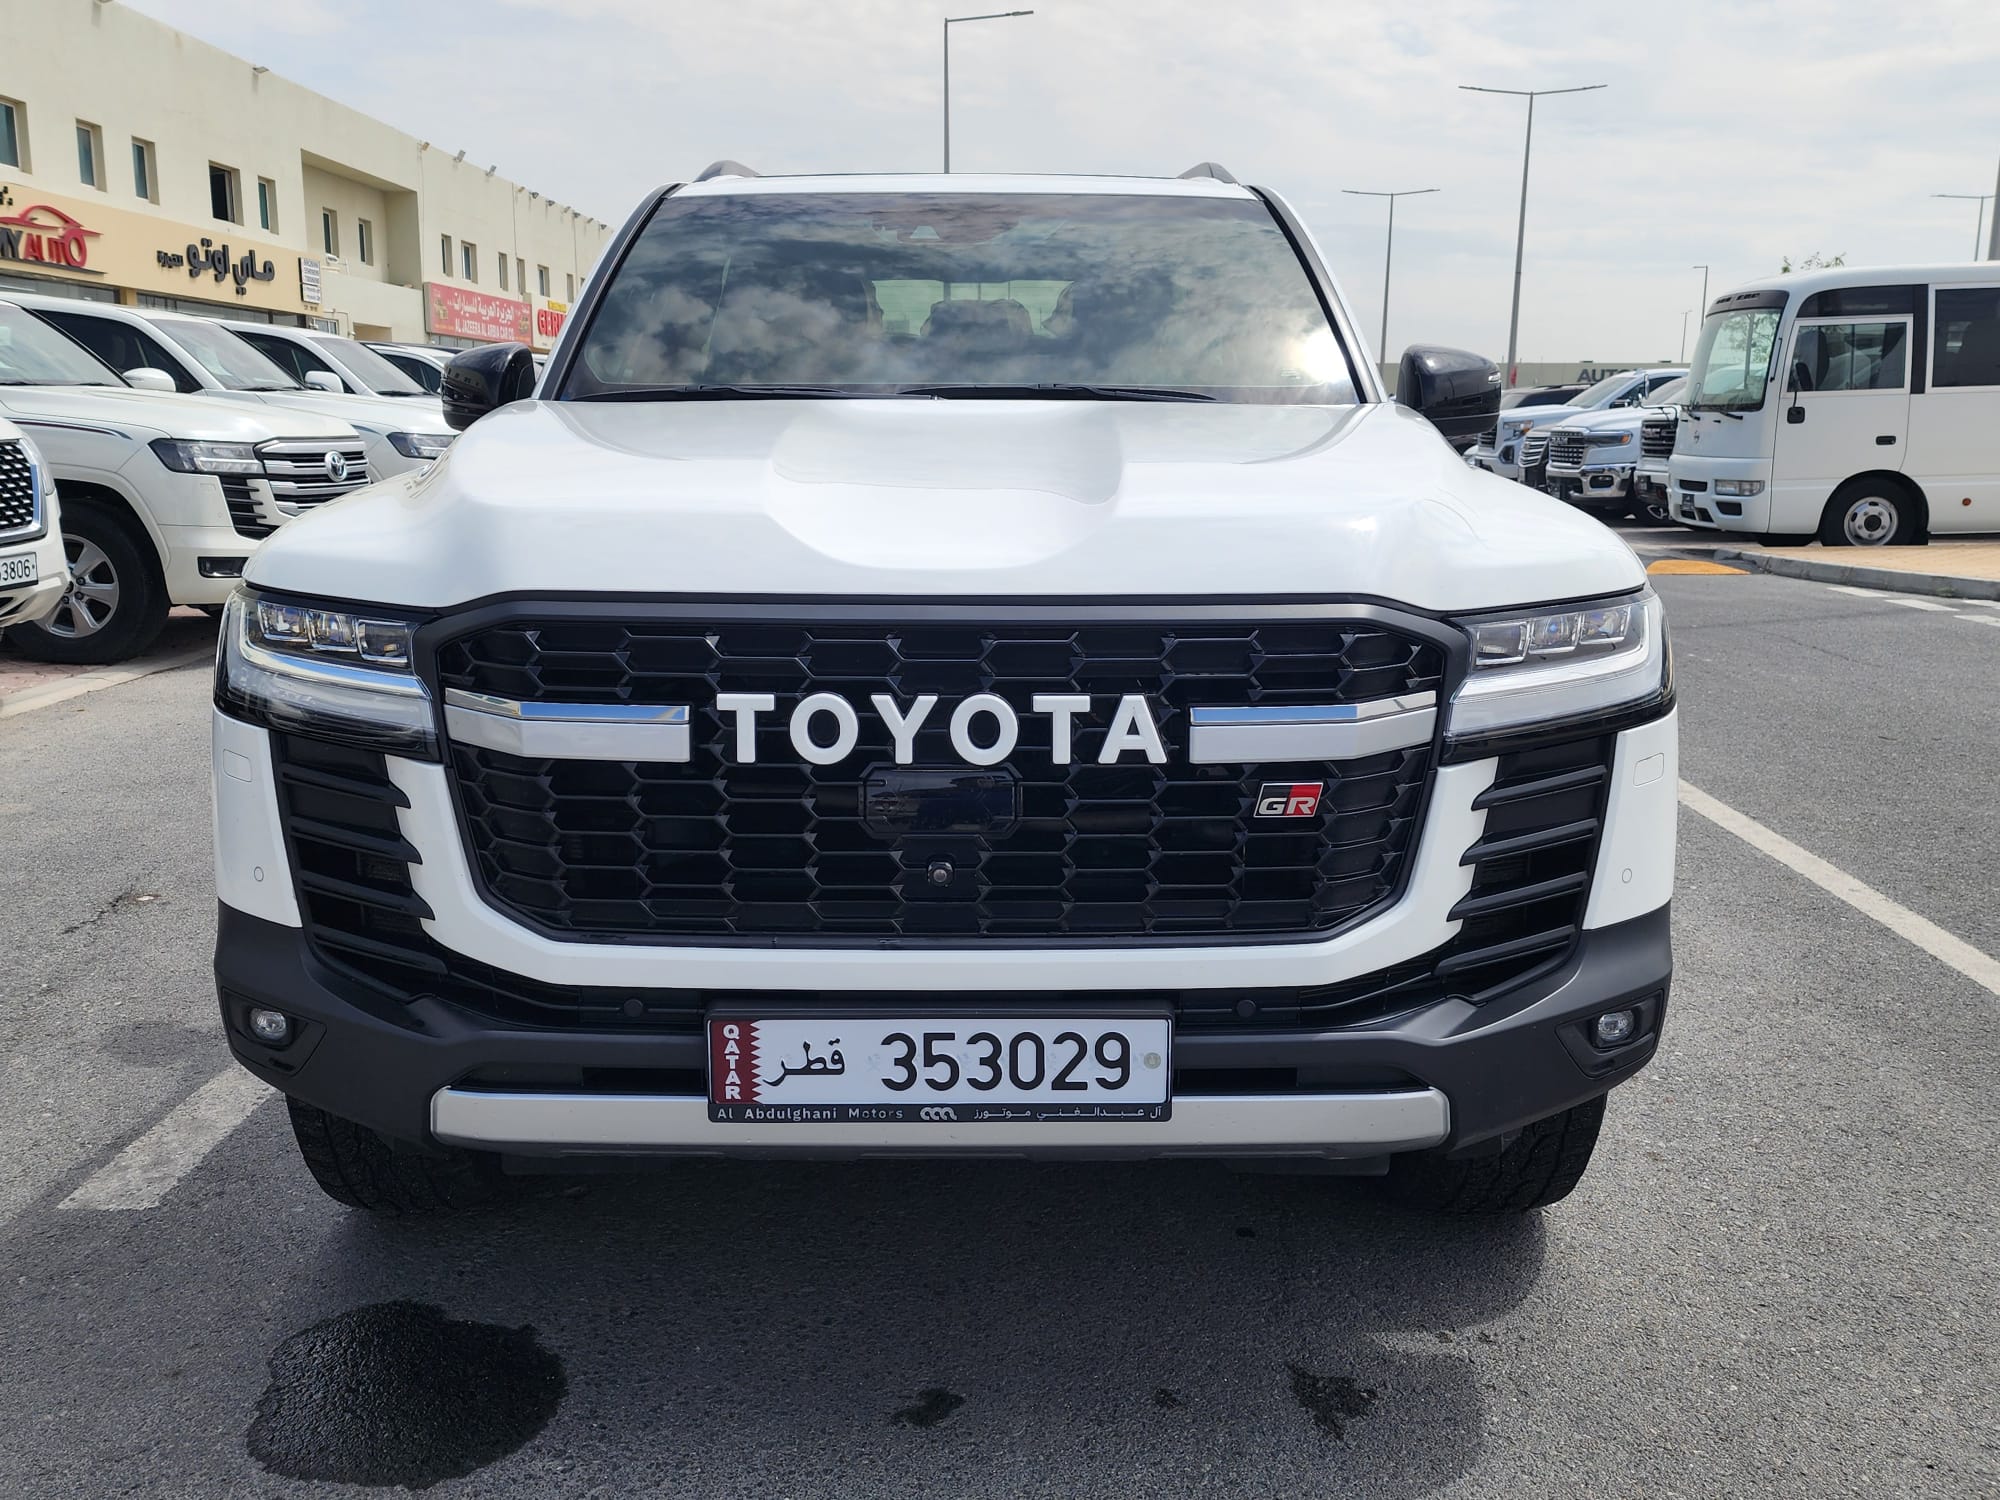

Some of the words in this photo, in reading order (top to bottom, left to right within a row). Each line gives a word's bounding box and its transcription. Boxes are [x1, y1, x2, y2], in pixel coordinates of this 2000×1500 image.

[186, 237, 231, 283] اوتو
[232, 250, 275, 295] ماي
[455, 318, 462, 333] AL
[0, 558, 30, 581] 3806
[716, 692, 1168, 766] TOYOTA
[1258, 796, 1316, 815] GR
[722, 1024, 742, 1100] QATAR
[762, 1038, 846, 1087] قطر
[880, 1031, 1131, 1092] 353029
[717, 1107, 734, 1119] Al
[744, 1107, 837, 1121] Abdulghani
[848, 1107, 904, 1119] Motors
[973, 1107, 1032, 1119] موتورز
[1149, 1106, 1162, 1119] آل
